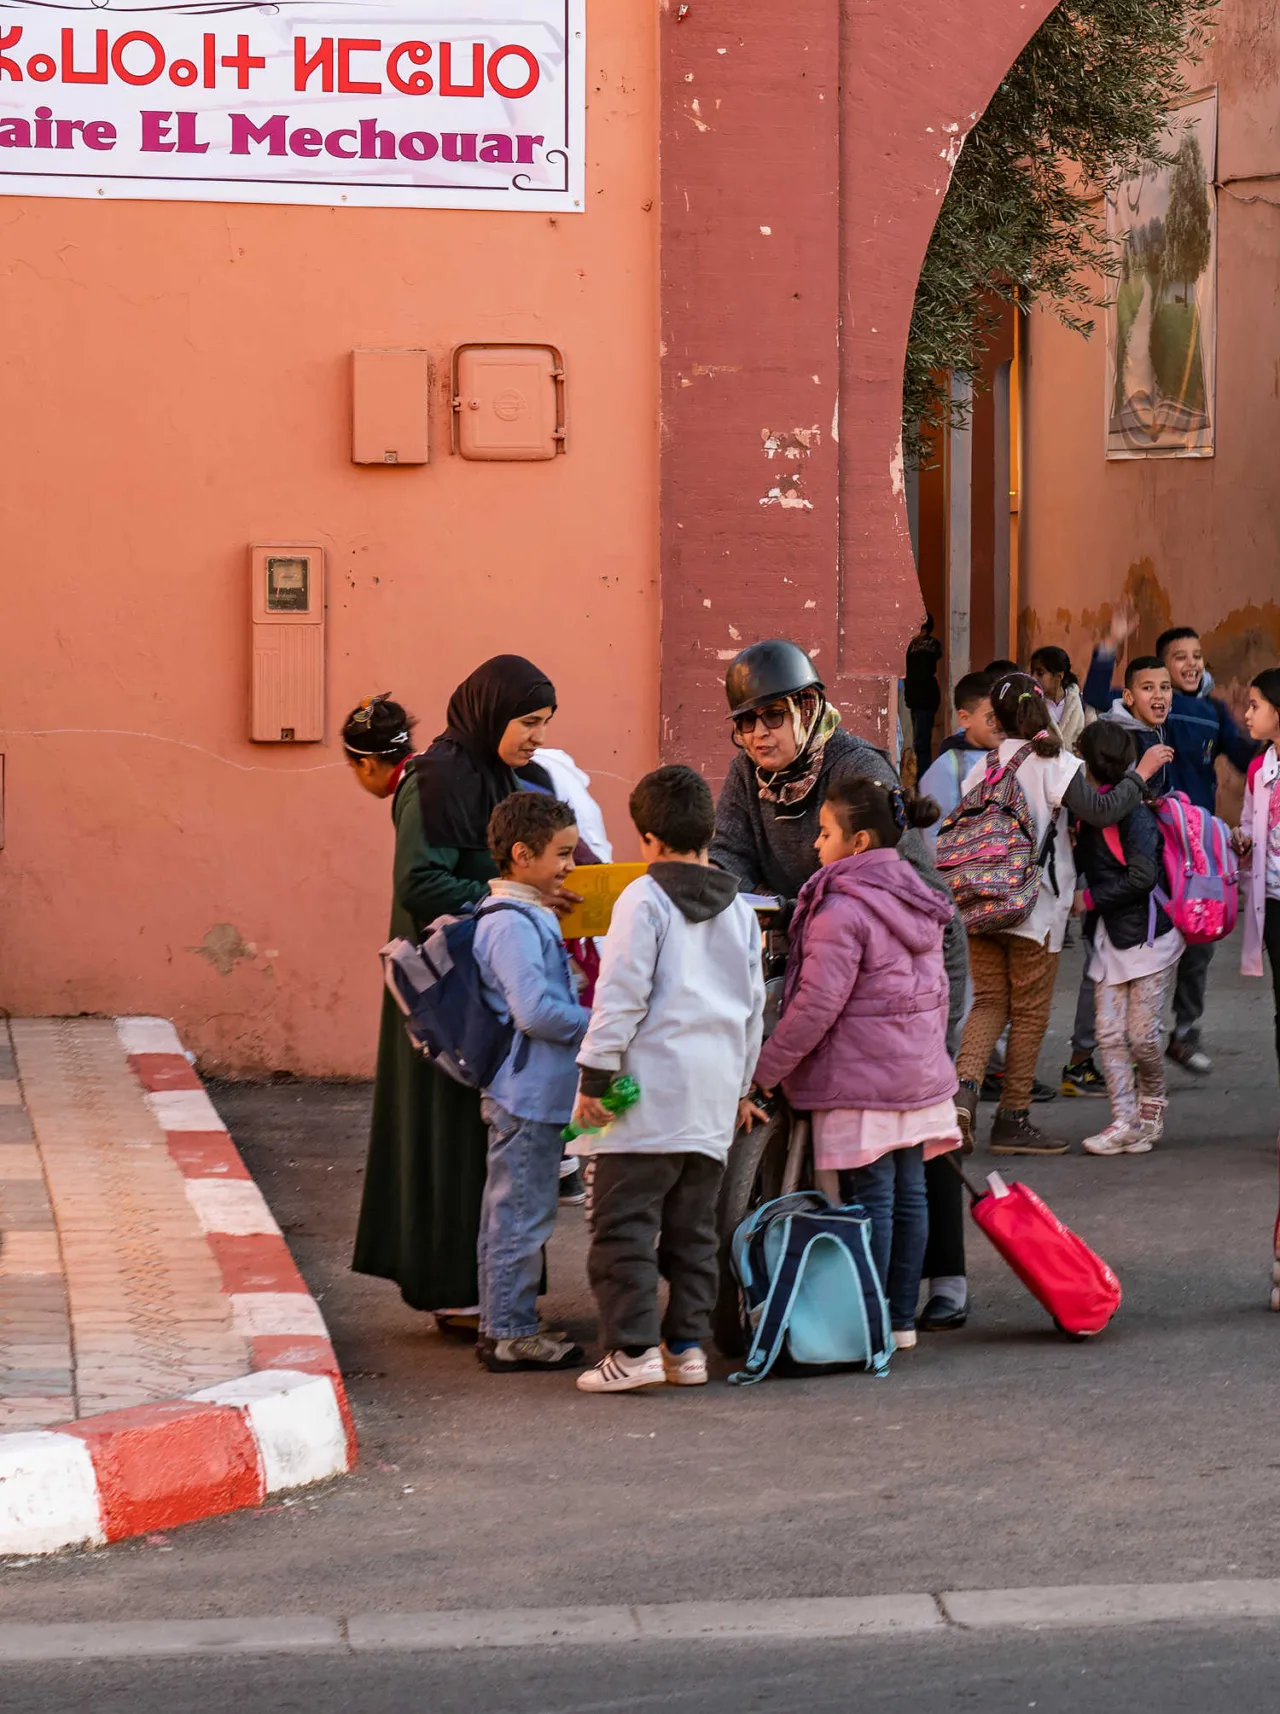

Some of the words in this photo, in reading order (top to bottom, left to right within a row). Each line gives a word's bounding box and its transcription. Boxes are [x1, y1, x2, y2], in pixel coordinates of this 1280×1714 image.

[0, 106, 117, 151] aire
[139, 110, 210, 154] EL
[229, 112, 545, 165] Mechouar
